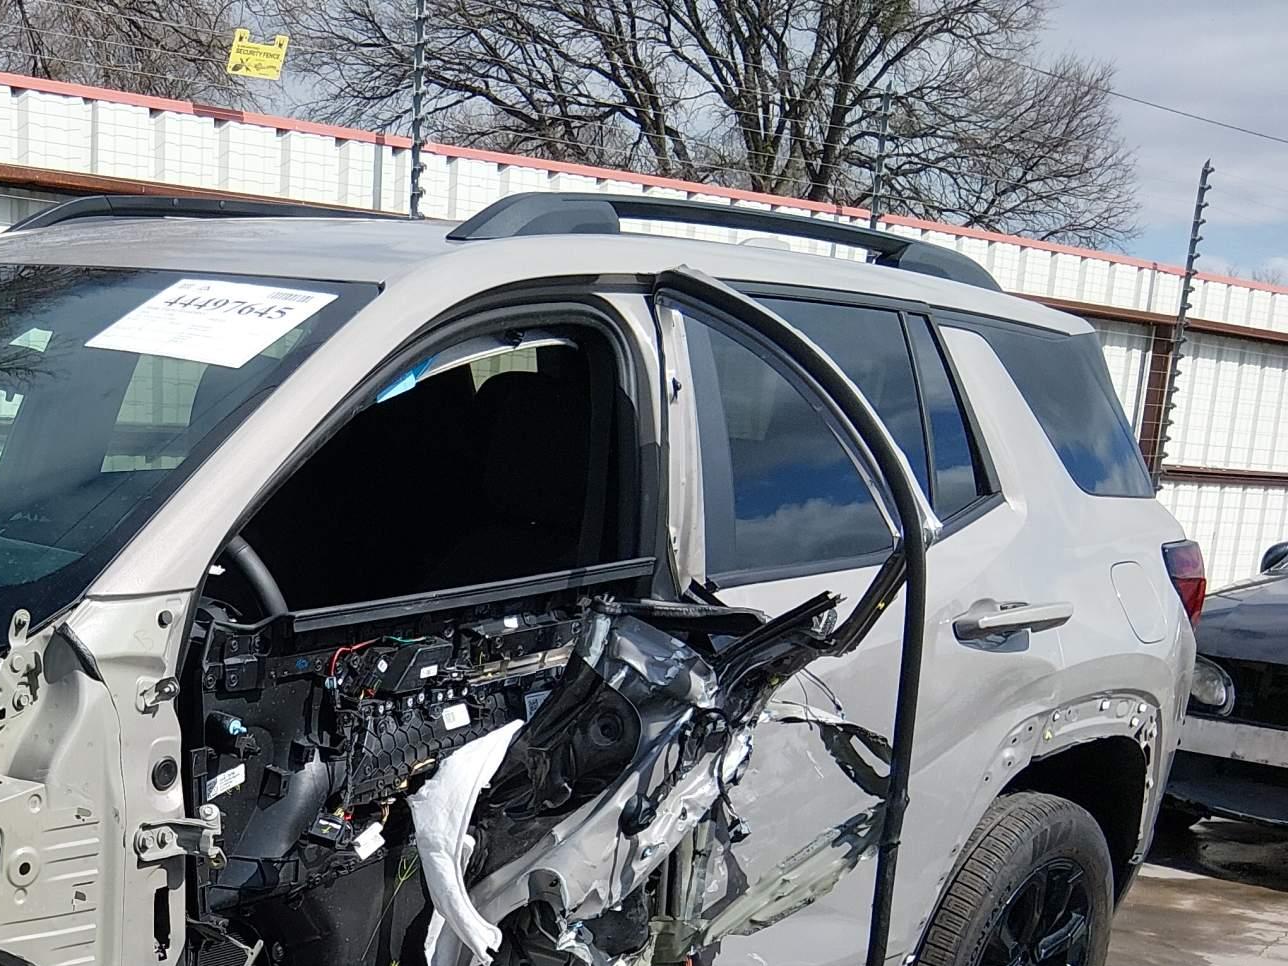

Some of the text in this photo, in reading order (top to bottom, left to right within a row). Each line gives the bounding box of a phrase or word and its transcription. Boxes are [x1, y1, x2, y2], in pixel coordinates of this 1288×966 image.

[235, 48, 281, 61] SECURITY FENCE
[164, 294, 294, 319] 44497645
